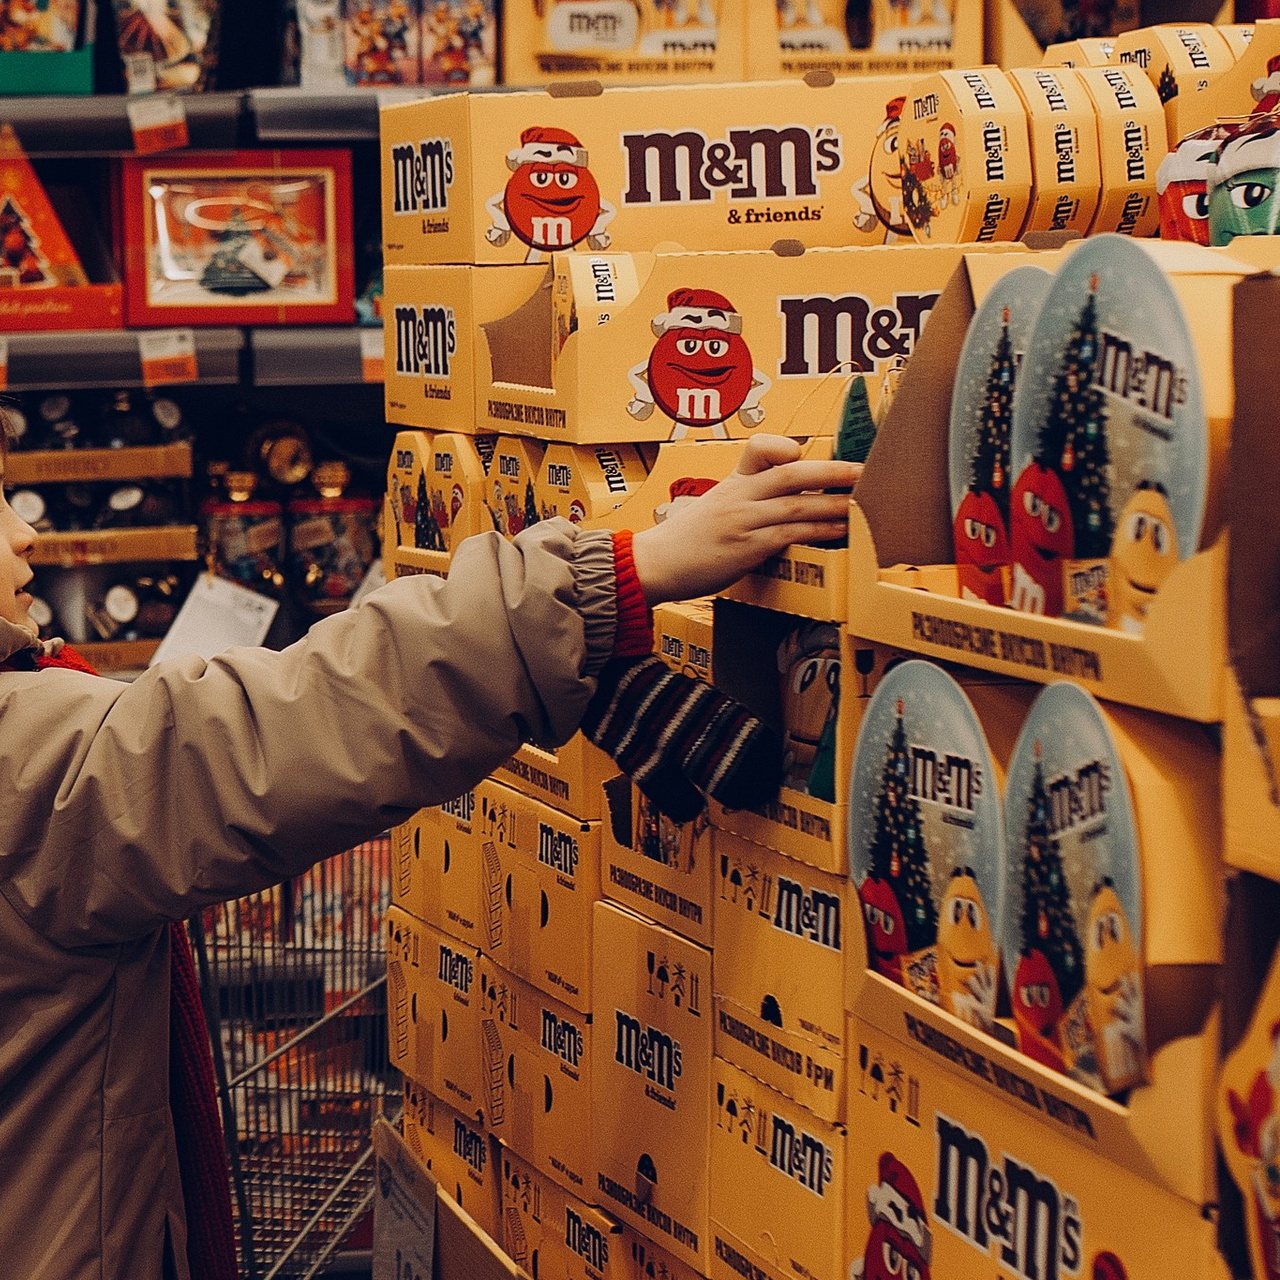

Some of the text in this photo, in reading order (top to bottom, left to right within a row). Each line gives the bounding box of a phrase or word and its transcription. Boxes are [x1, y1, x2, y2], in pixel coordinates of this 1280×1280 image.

[1120, 47, 1151, 68] m&m's
[392, 137, 454, 215] m&m's
[624, 126, 841, 205] m&m's
[981, 121, 1005, 182] m&m's
[1052, 123, 1075, 184] m&m's
[1124, 121, 1146, 182] m&m's
[727, 207, 822, 224] & friends
[395, 304, 455, 377] m&m's
[538, 821, 578, 878] m&m's
[439, 943, 473, 994] m&m's
[541, 1008, 583, 1068] m&m's
[615, 1009, 683, 1091] m&m's
[770, 1113, 834, 1198] m&m's
[566, 1206, 609, 1273] m&m's
